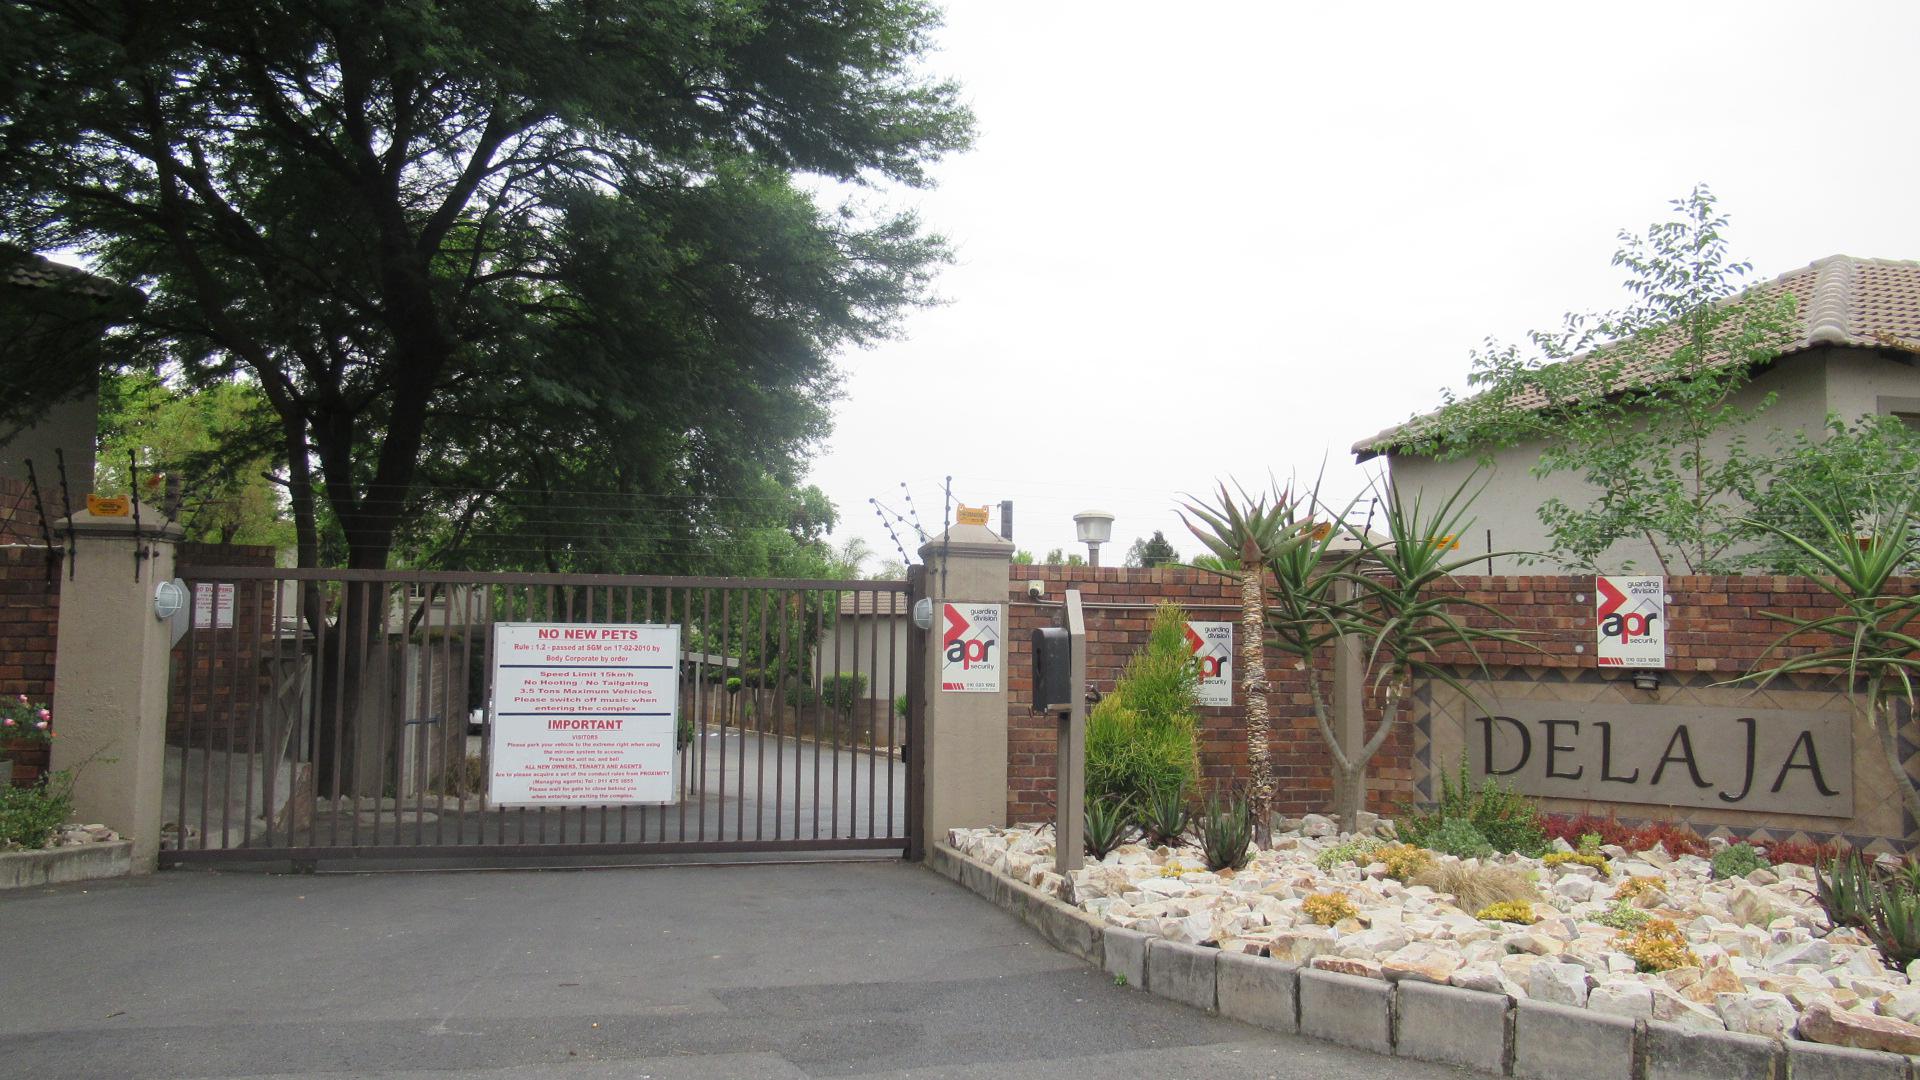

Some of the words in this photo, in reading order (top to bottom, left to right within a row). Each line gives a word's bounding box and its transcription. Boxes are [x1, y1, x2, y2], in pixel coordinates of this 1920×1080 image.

[539, 628, 559, 639] NO
[565, 629, 597, 639] NEW
[602, 629, 638, 640] PETS
[1602, 613, 1657, 644] apr
[947, 639, 994, 670] apr
[548, 720, 623, 730] IMPORTANT
[1475, 716, 1840, 802] DELAJA
